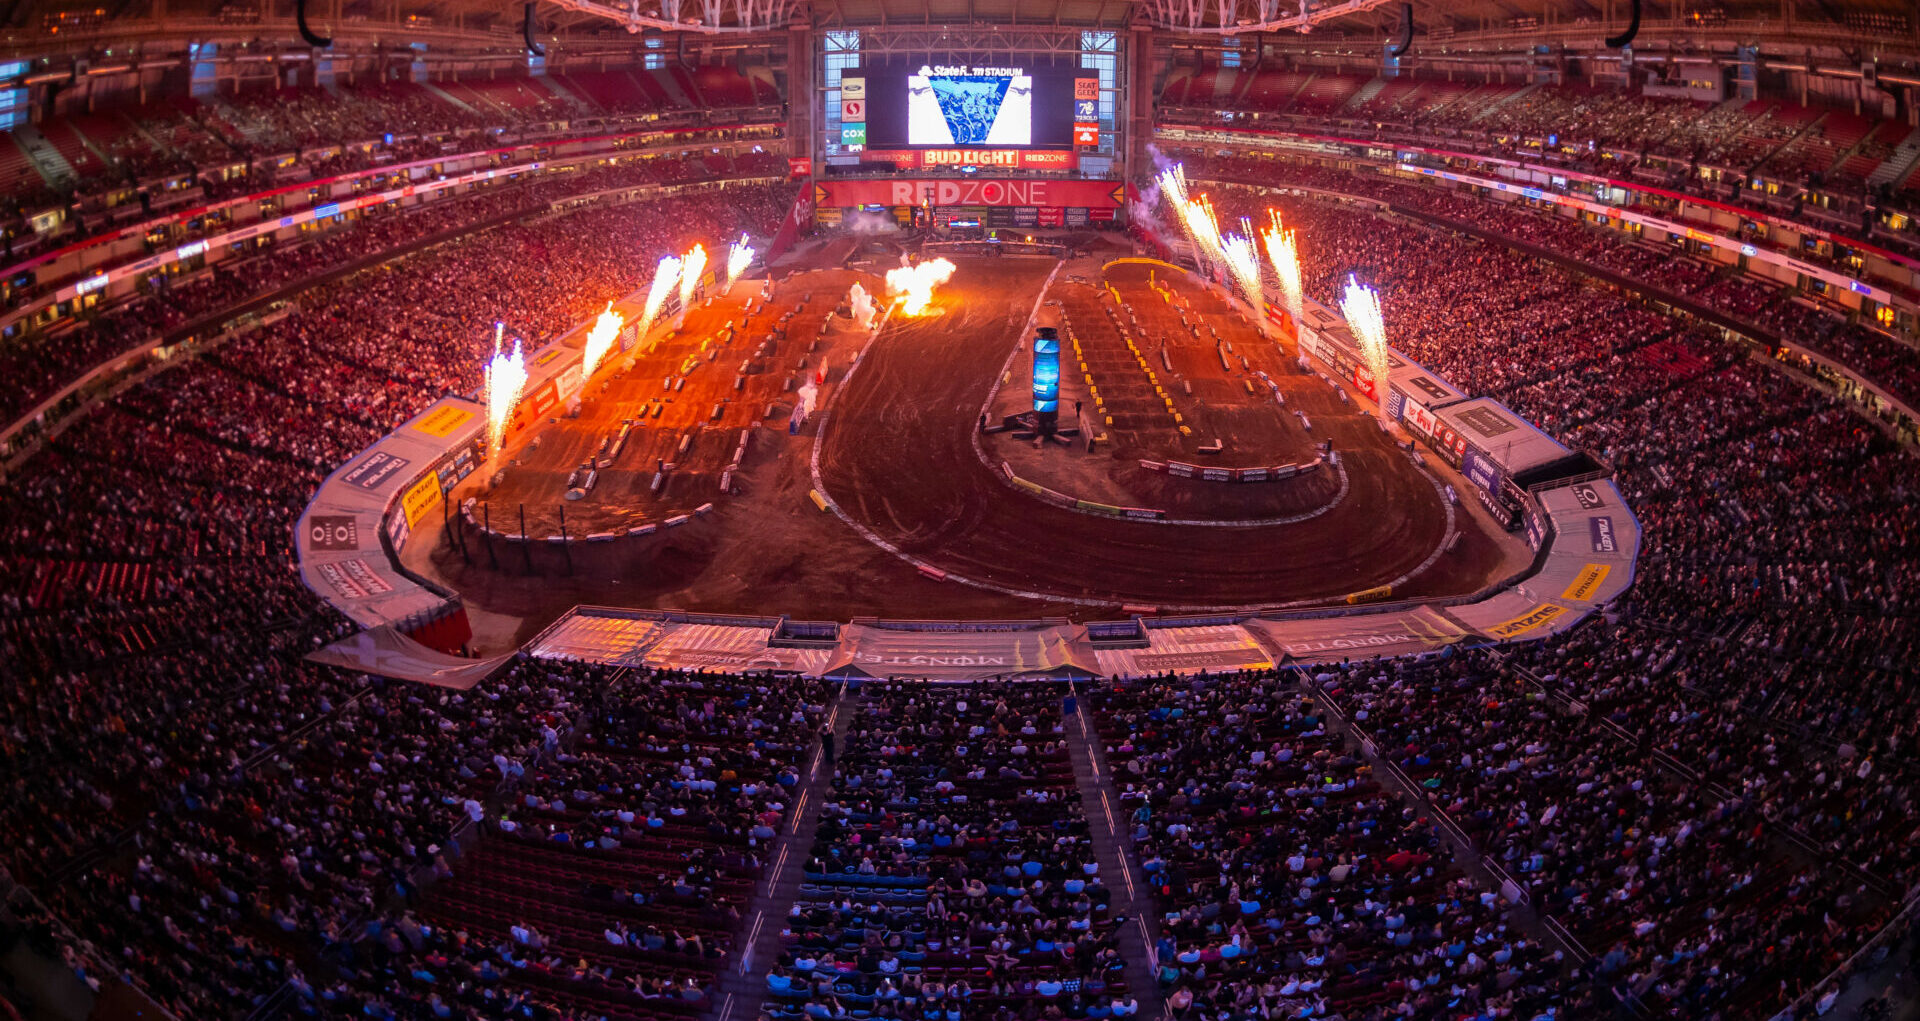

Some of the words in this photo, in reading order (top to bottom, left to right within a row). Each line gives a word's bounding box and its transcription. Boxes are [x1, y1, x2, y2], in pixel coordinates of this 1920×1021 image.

[985, 67, 1023, 76] STADIUM
[842, 129, 865, 138] COX
[924, 150, 962, 164] BUD
[963, 150, 1016, 164] LIGHT
[1024, 154, 1068, 162] REDZONE
[892, 181, 1047, 205] REDZONE
[345, 452, 386, 481] FALKEN
[362, 458, 401, 487] FALKEN
[408, 477, 434, 503] DUNLOP
[411, 490, 438, 519] DUNLOP
[1484, 497, 1509, 525] OAKLEY
[1598, 518, 1614, 551] FALKEN
[1575, 571, 1598, 599] DUNLOP
[1494, 606, 1560, 635] SUZUKI
